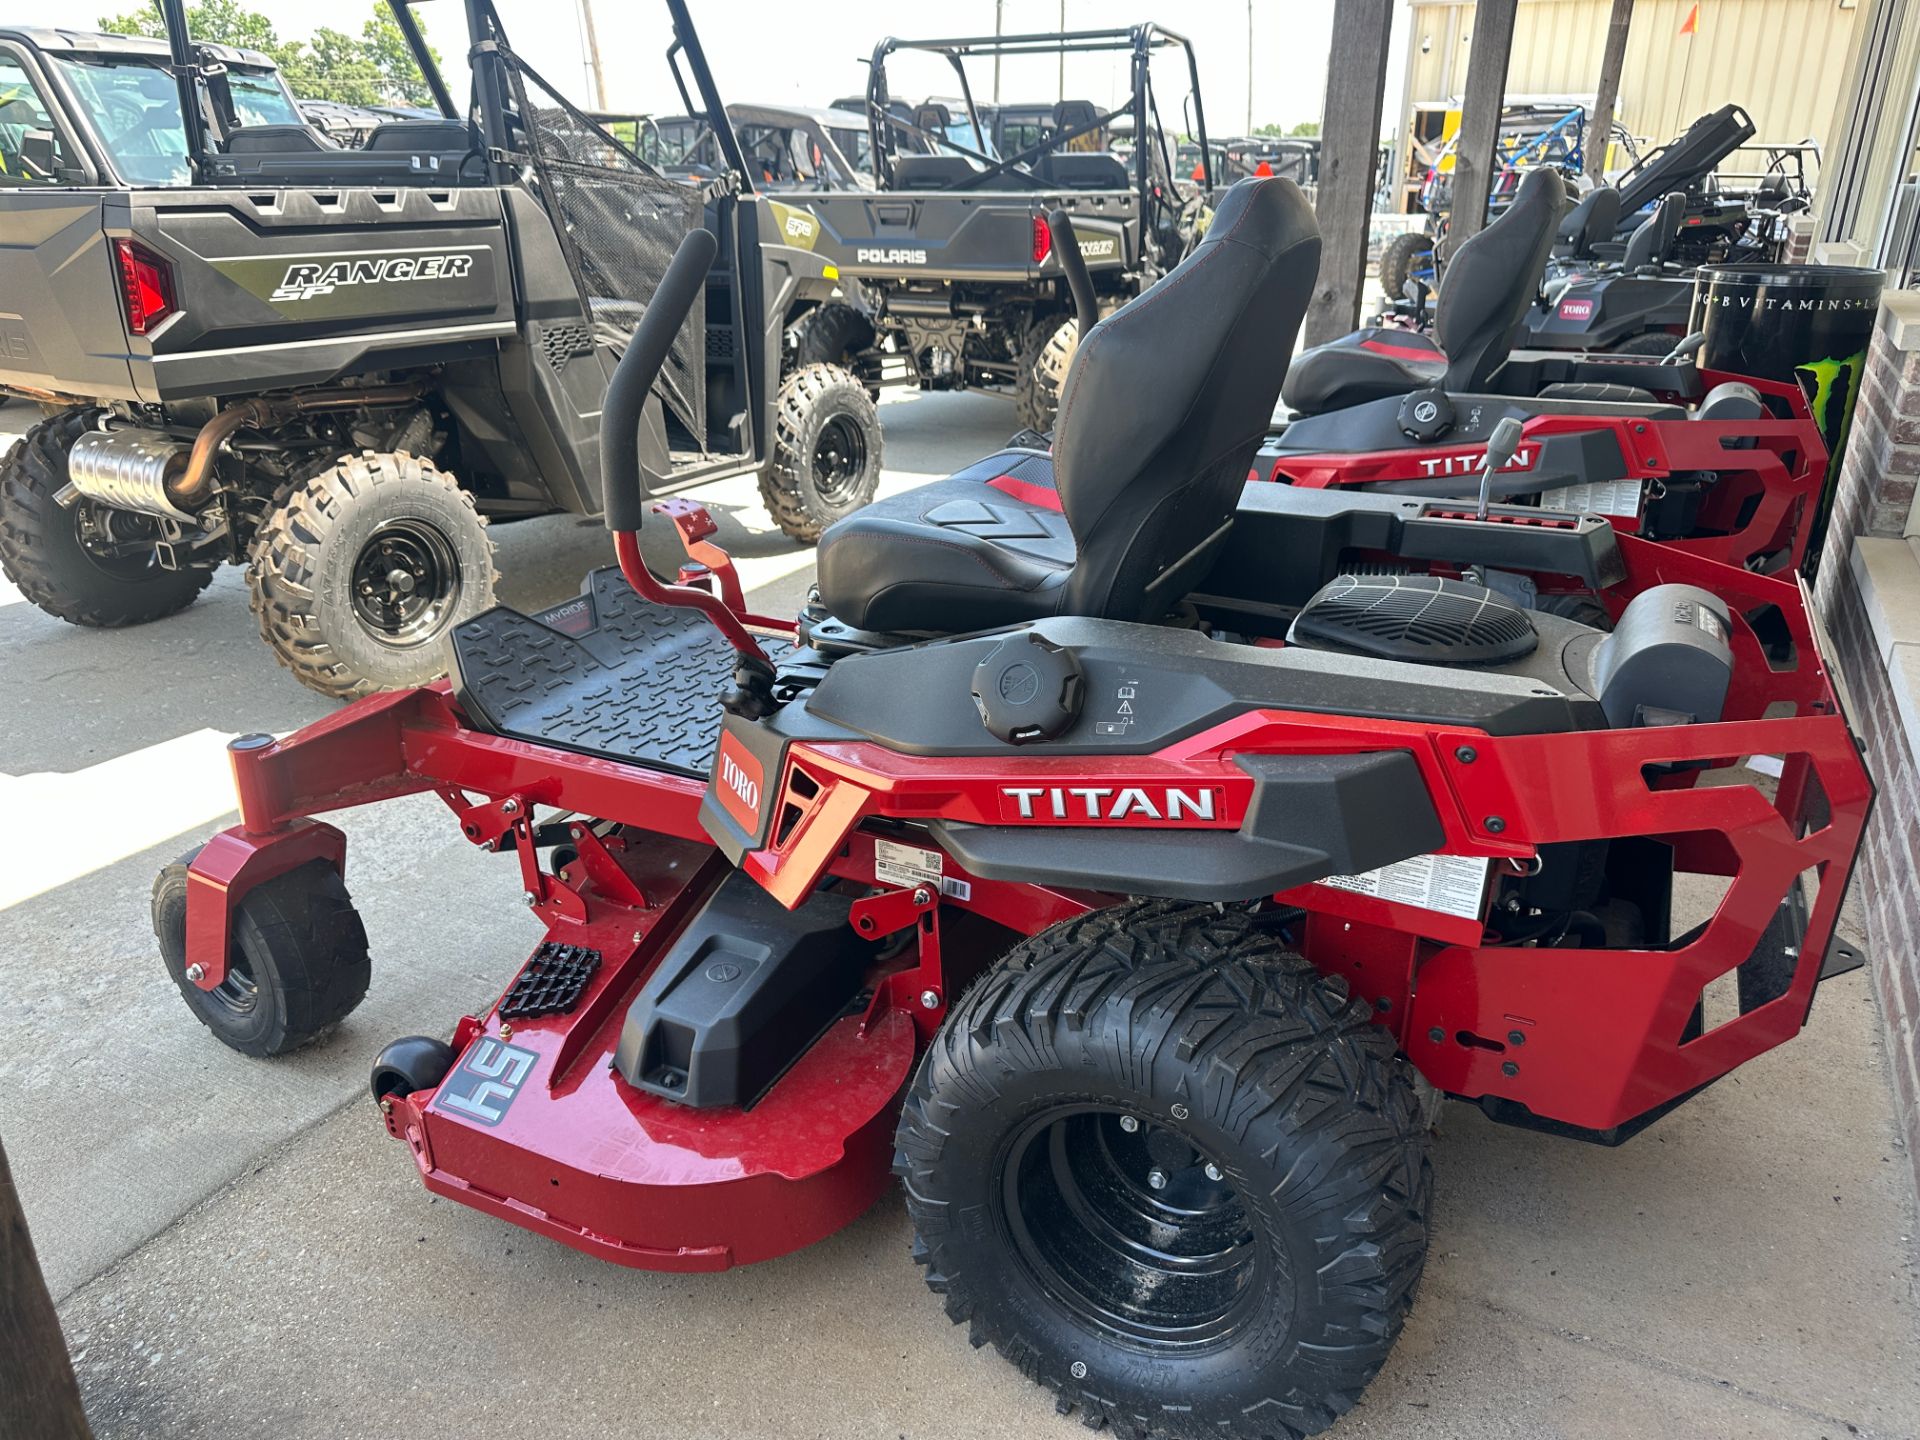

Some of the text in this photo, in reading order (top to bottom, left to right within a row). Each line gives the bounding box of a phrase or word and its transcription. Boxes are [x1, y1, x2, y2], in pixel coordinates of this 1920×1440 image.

[857, 248, 927, 264] POLARIS
[280, 254, 473, 289] RANGER
[269, 285, 335, 302] SP
[1563, 304, 1590, 315] TORO
[722, 752, 758, 809] TORO
[1002, 787, 1215, 821] TITAN
